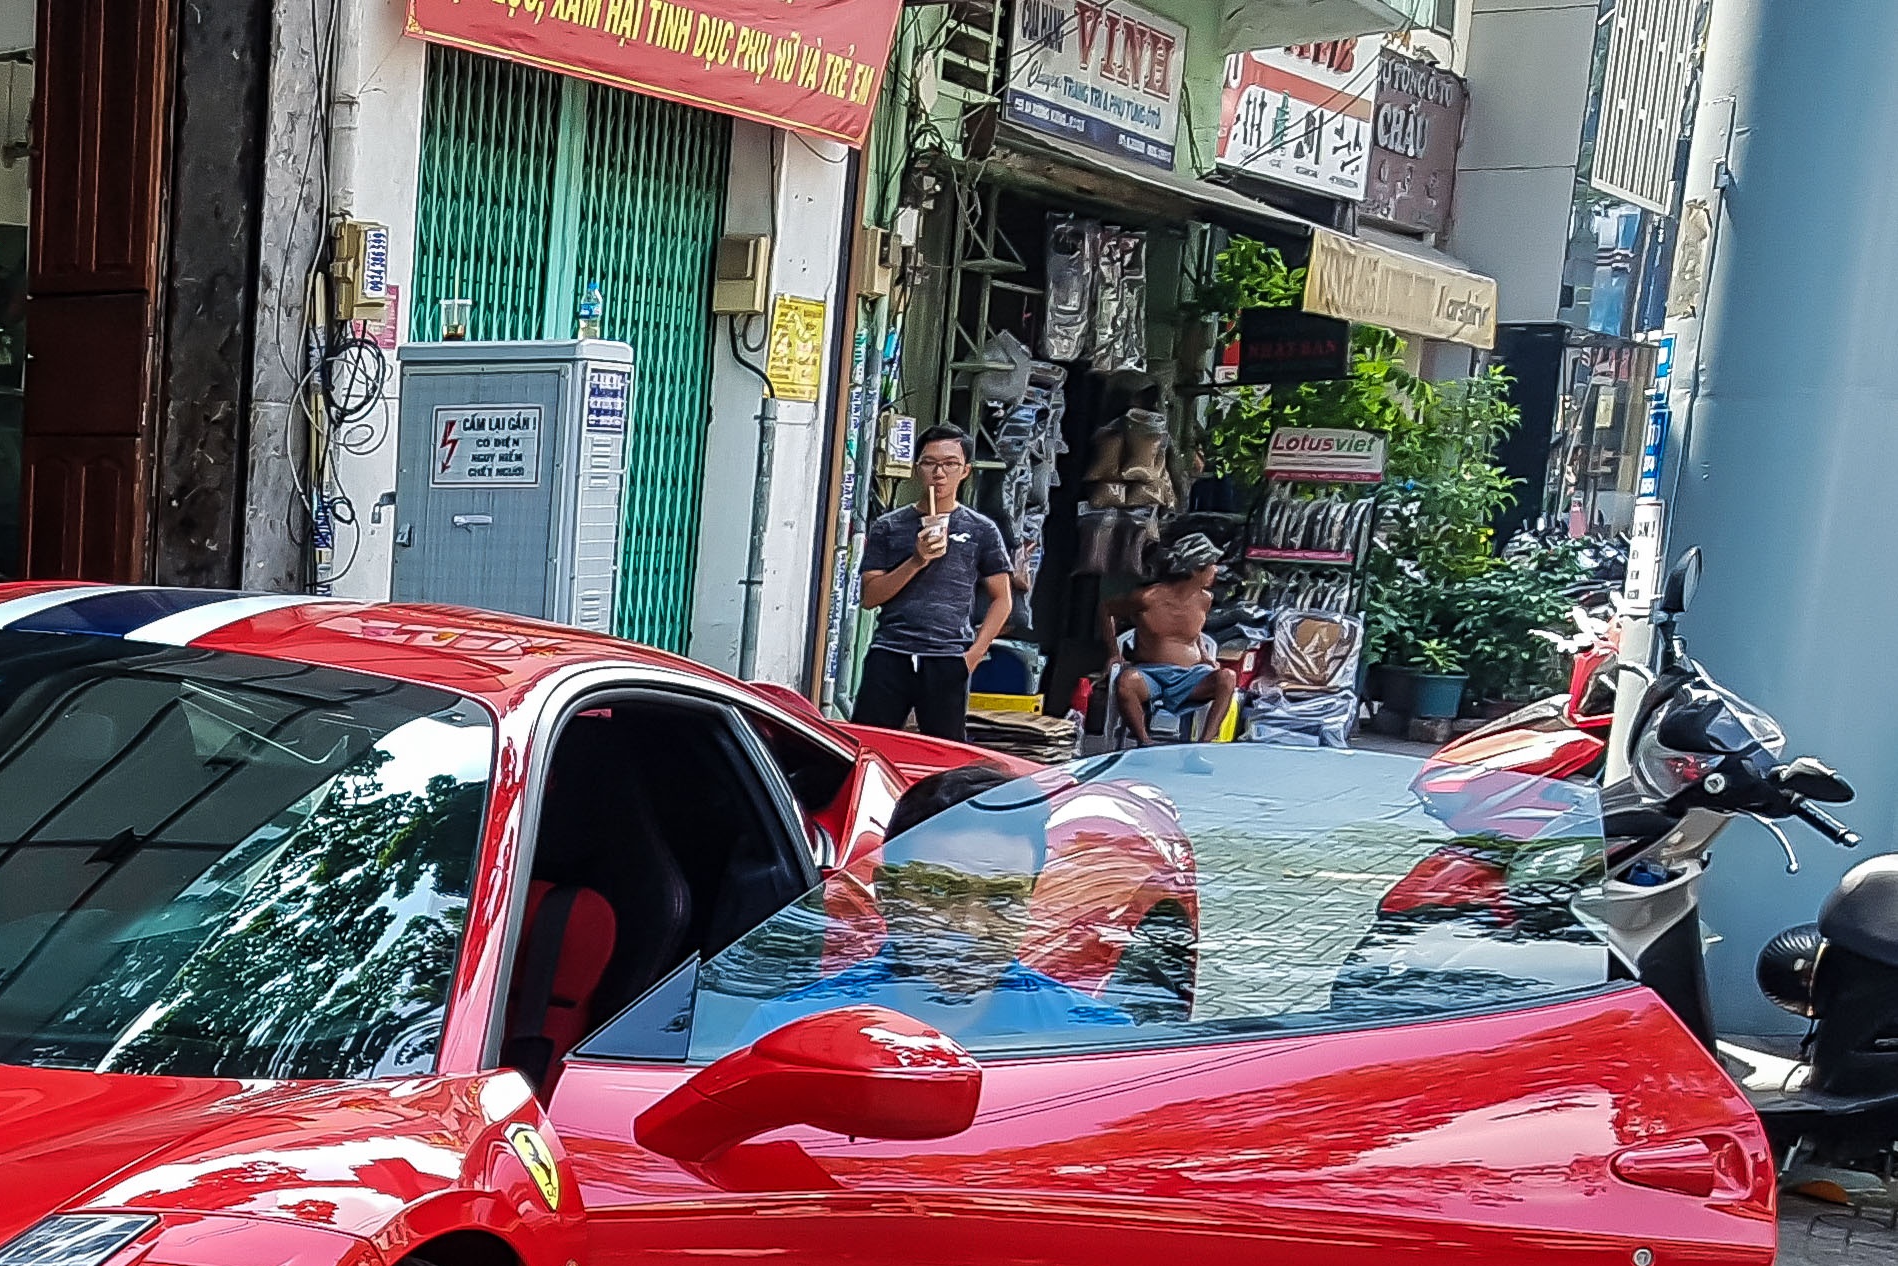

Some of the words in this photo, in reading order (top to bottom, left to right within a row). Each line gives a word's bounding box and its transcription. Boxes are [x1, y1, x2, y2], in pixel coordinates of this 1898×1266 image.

[693, 13, 735, 71] DỤC
[732, 26, 773, 85] PHỤ
[771, 31, 801, 83] NỮ
[797, 37, 823, 90] VÀ
[820, 44, 855, 99] TRẺ
[1075, 1, 1175, 102] VINH
